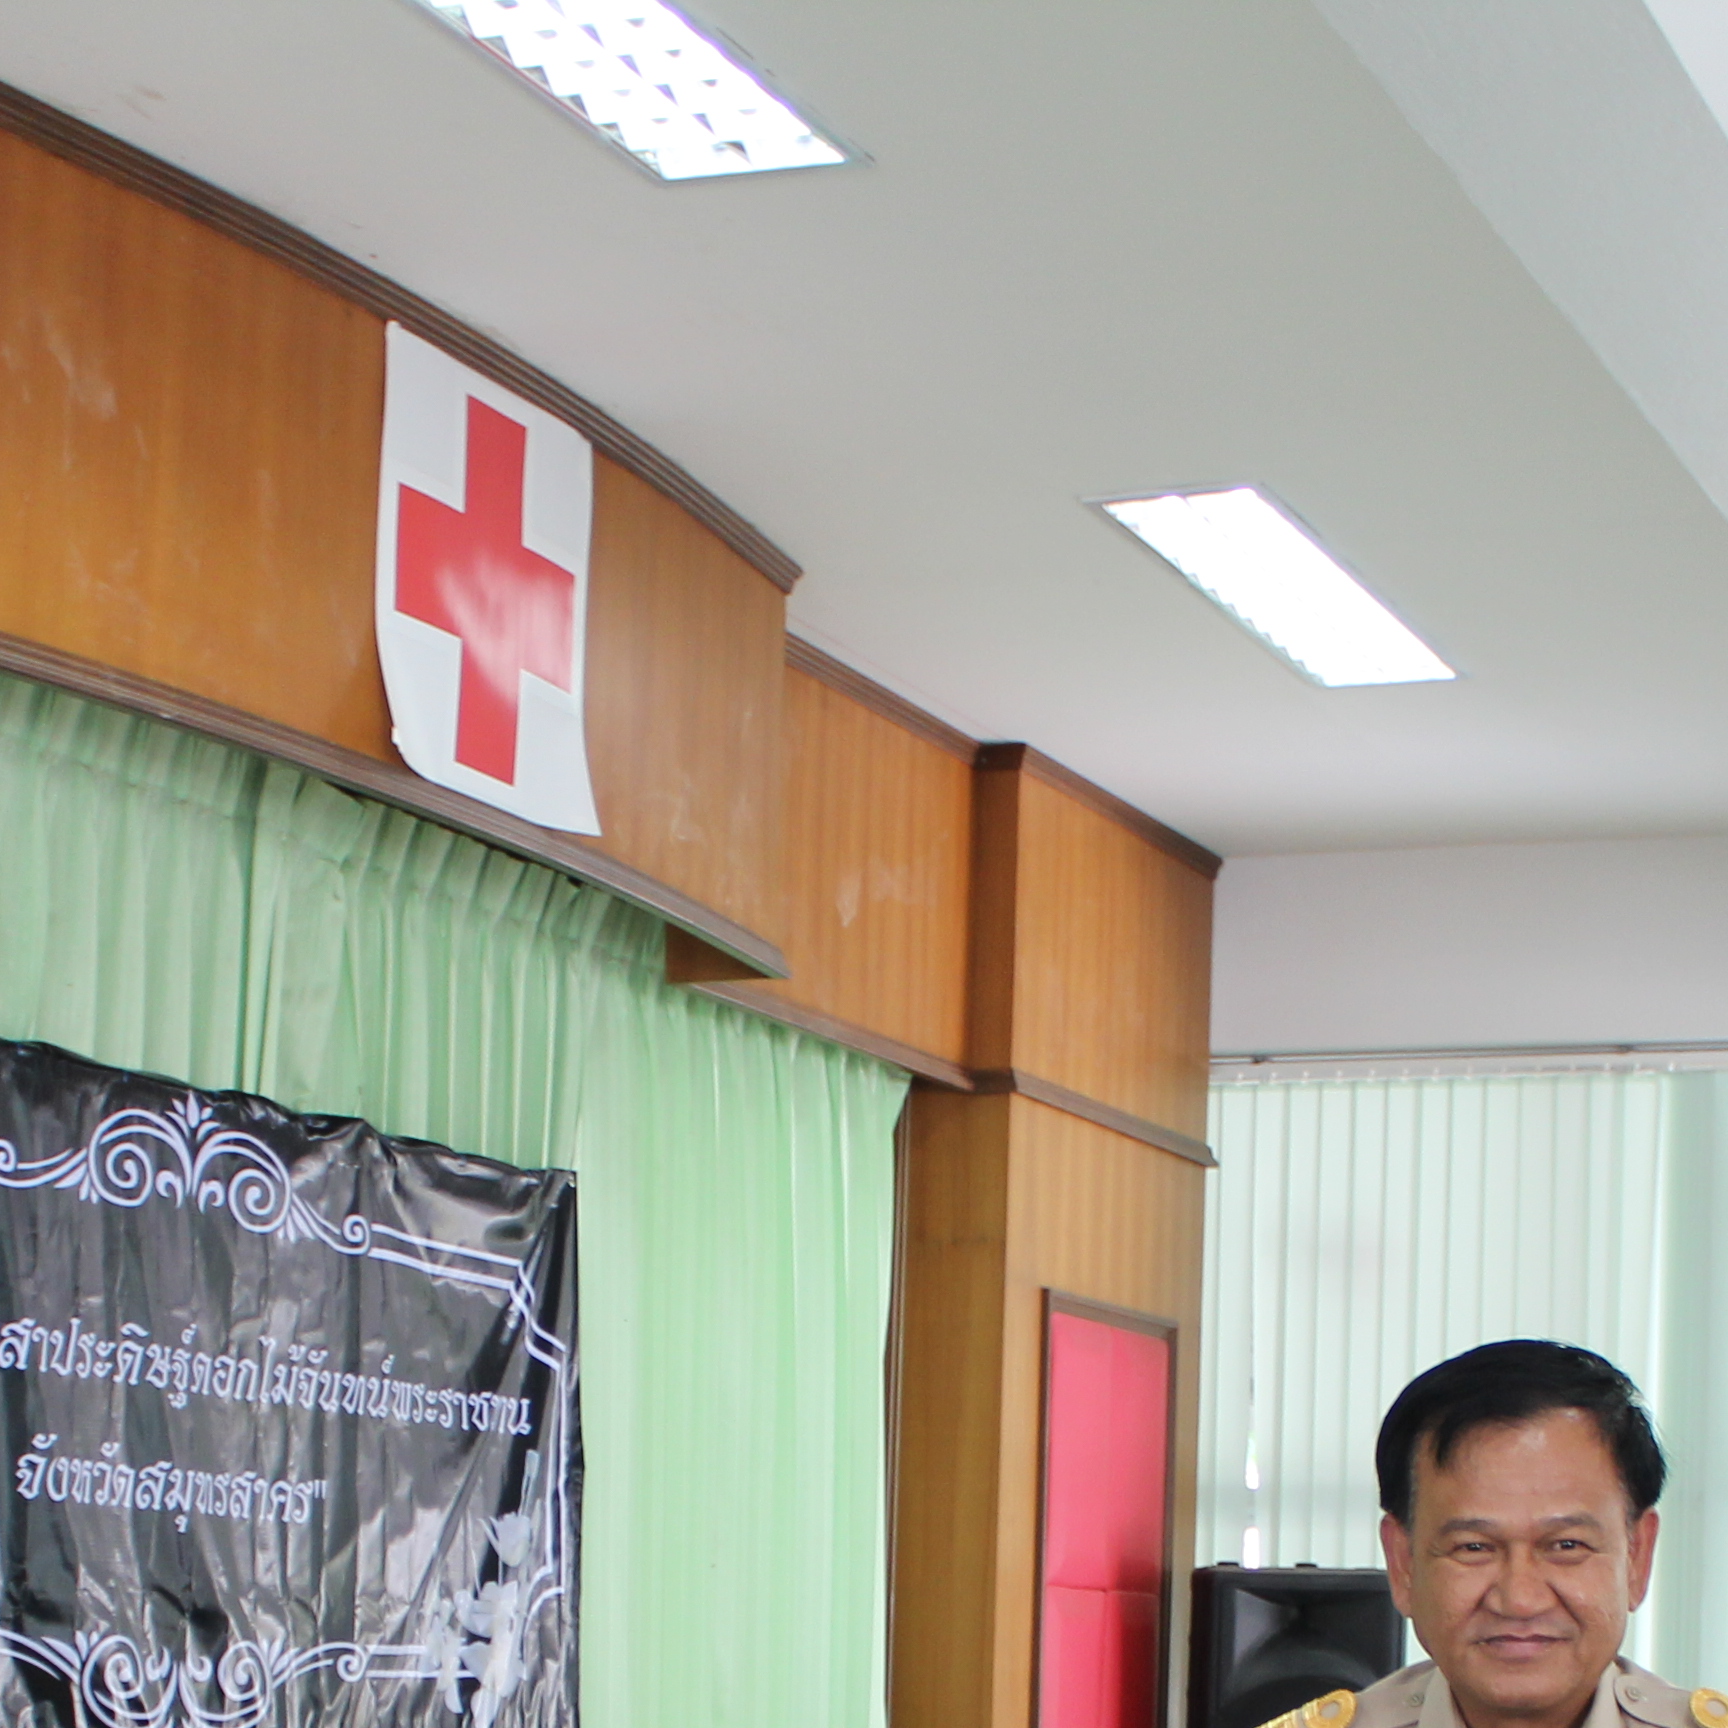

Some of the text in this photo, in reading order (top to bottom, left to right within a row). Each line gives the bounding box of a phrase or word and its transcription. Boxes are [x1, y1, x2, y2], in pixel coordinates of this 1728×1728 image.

[15, 1432, 328, 1533] จังหวัดสมุทรสาคร"
